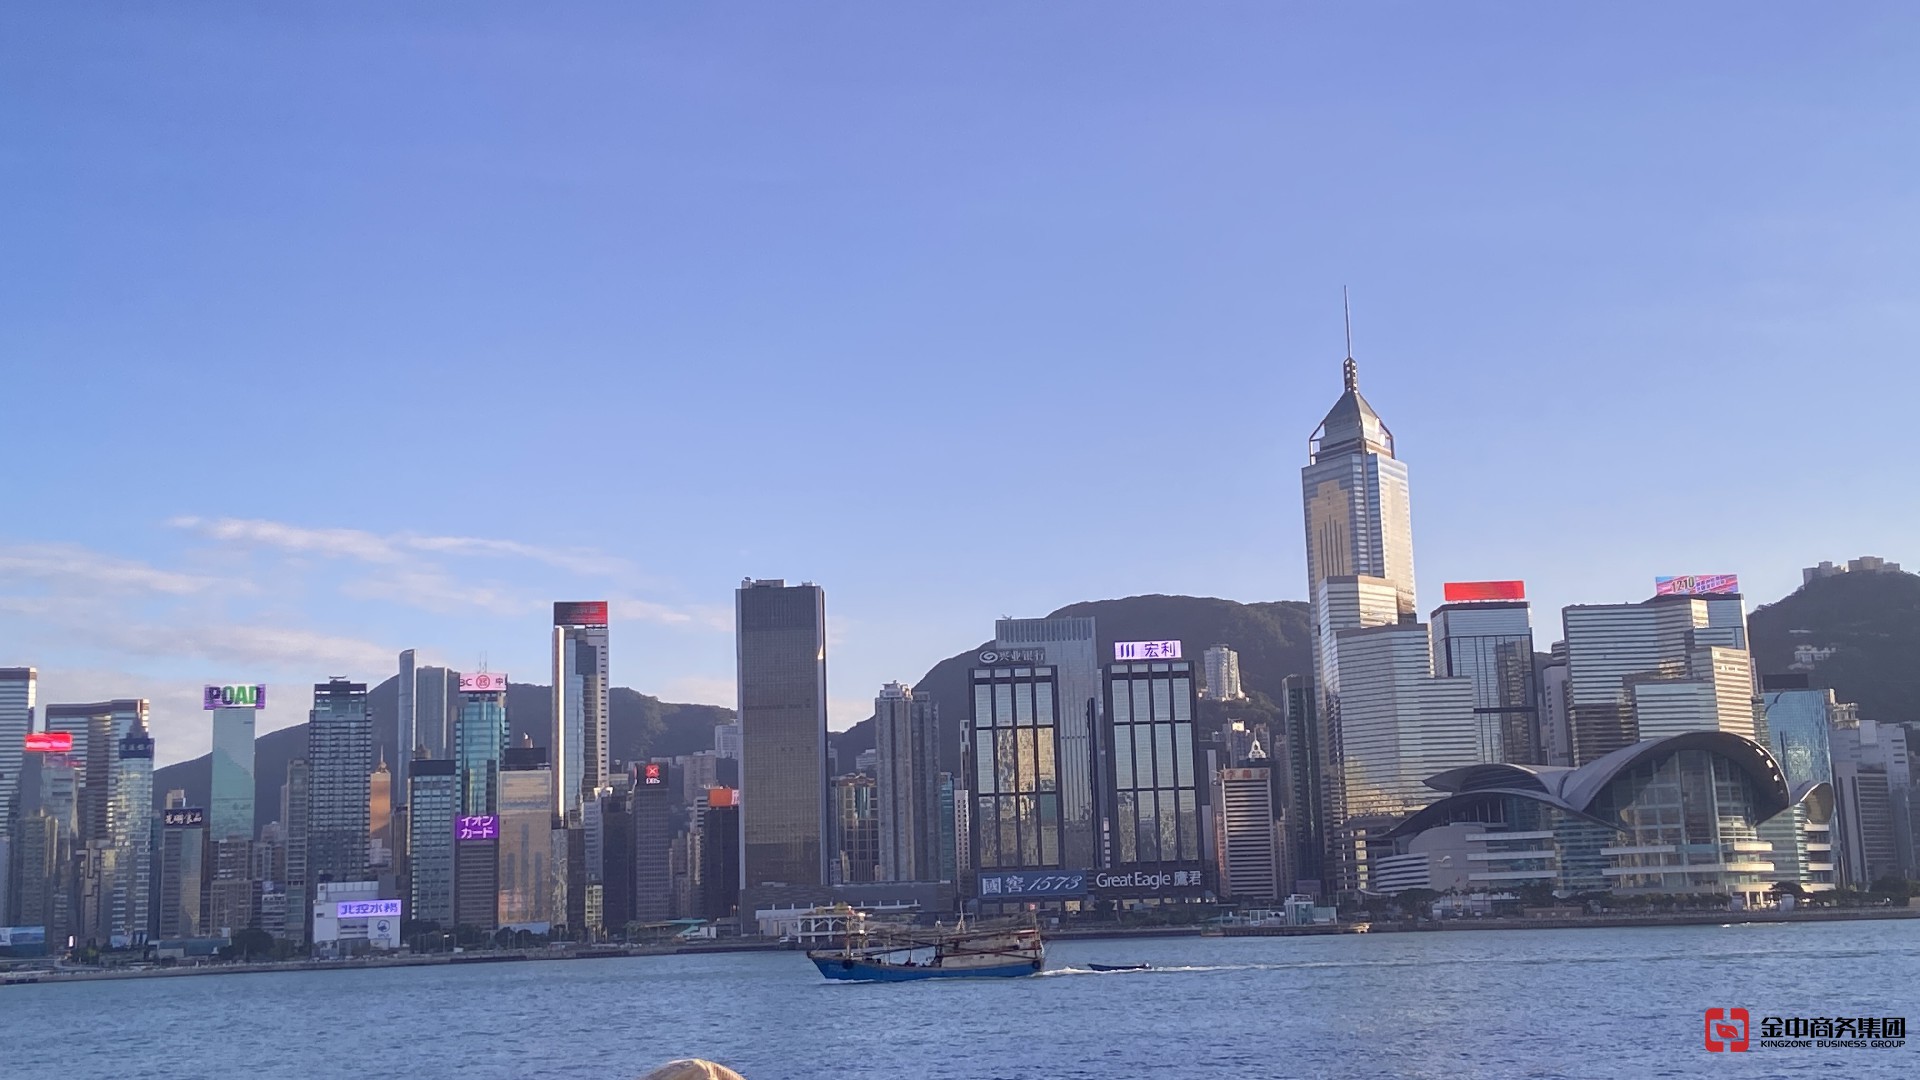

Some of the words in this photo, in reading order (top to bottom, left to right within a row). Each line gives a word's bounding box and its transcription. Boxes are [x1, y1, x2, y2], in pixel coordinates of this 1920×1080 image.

[999, 651, 1045, 662] 兴业银行
[1145, 642, 1176, 657] 宏利
[208, 686, 260, 705] POAD
[461, 816, 494, 827] イオン
[461, 827, 494, 839] カード
[1027, 875, 1083, 891] 1573
[1096, 872, 1133, 888] Great
[1134, 871, 1171, 890] Eagle
[1173, 870, 1201, 887] 鷹君
